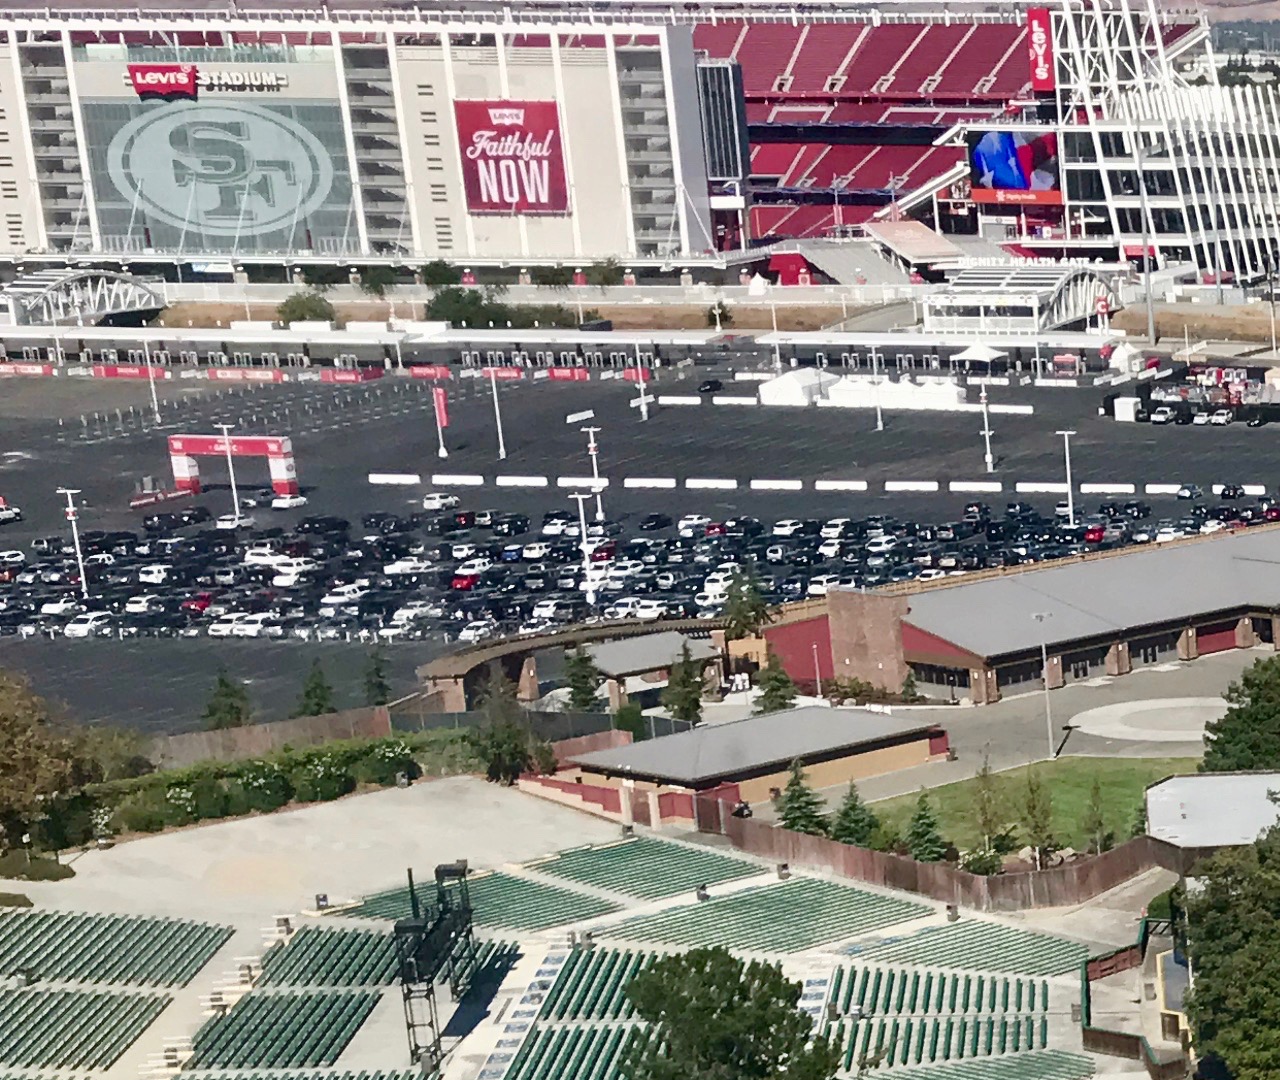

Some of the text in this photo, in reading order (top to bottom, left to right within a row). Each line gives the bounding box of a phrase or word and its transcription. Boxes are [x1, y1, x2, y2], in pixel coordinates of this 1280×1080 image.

[197, 71, 278, 86] STADIUM
[466, 129, 554, 161] Faithful
[476, 159, 549, 203] NOW
[957, 257, 1104, 267] DIGNITY HEALTH GATE C
[1096, 300, 1107, 313] C
